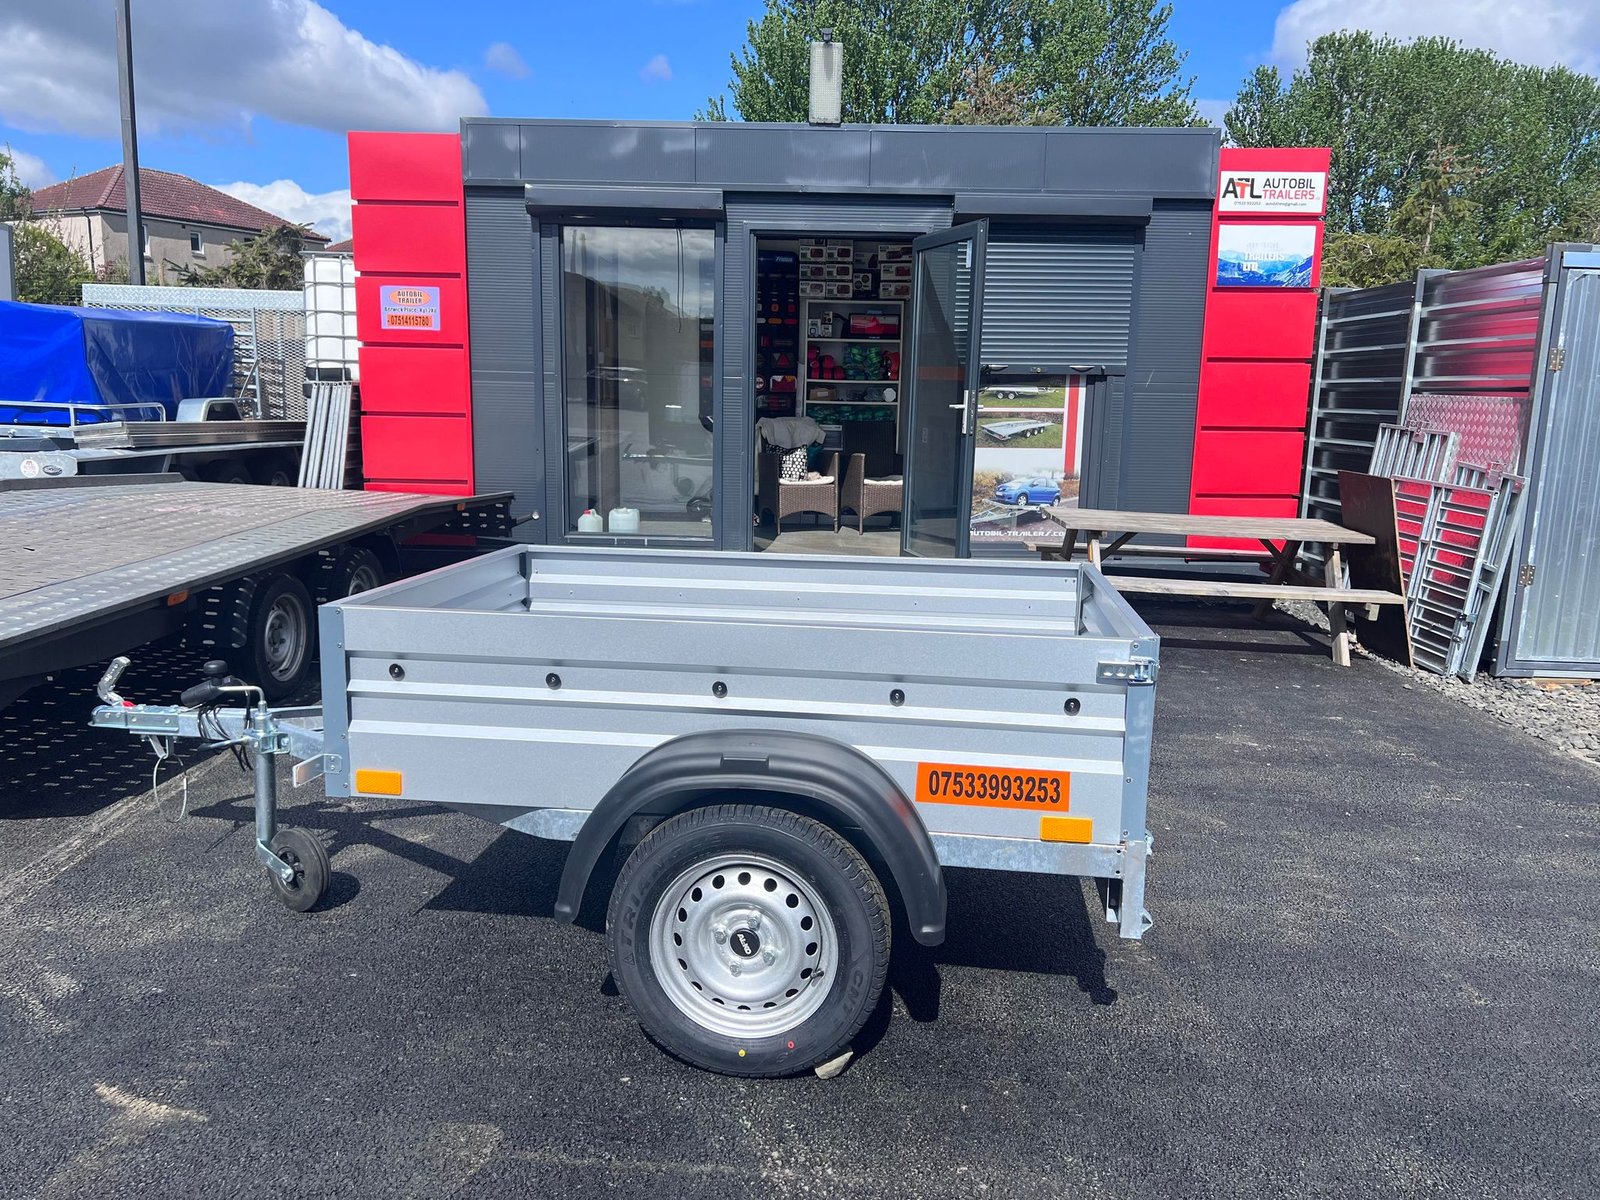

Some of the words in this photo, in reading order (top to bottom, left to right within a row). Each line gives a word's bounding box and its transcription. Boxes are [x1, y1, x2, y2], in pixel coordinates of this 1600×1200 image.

[1221, 177, 1262, 199] ATL
[1262, 177, 1316, 190] AUTOBIL
[1262, 189, 1315, 200] TRAILERS
[928, 769, 1062, 804] 07533993253
